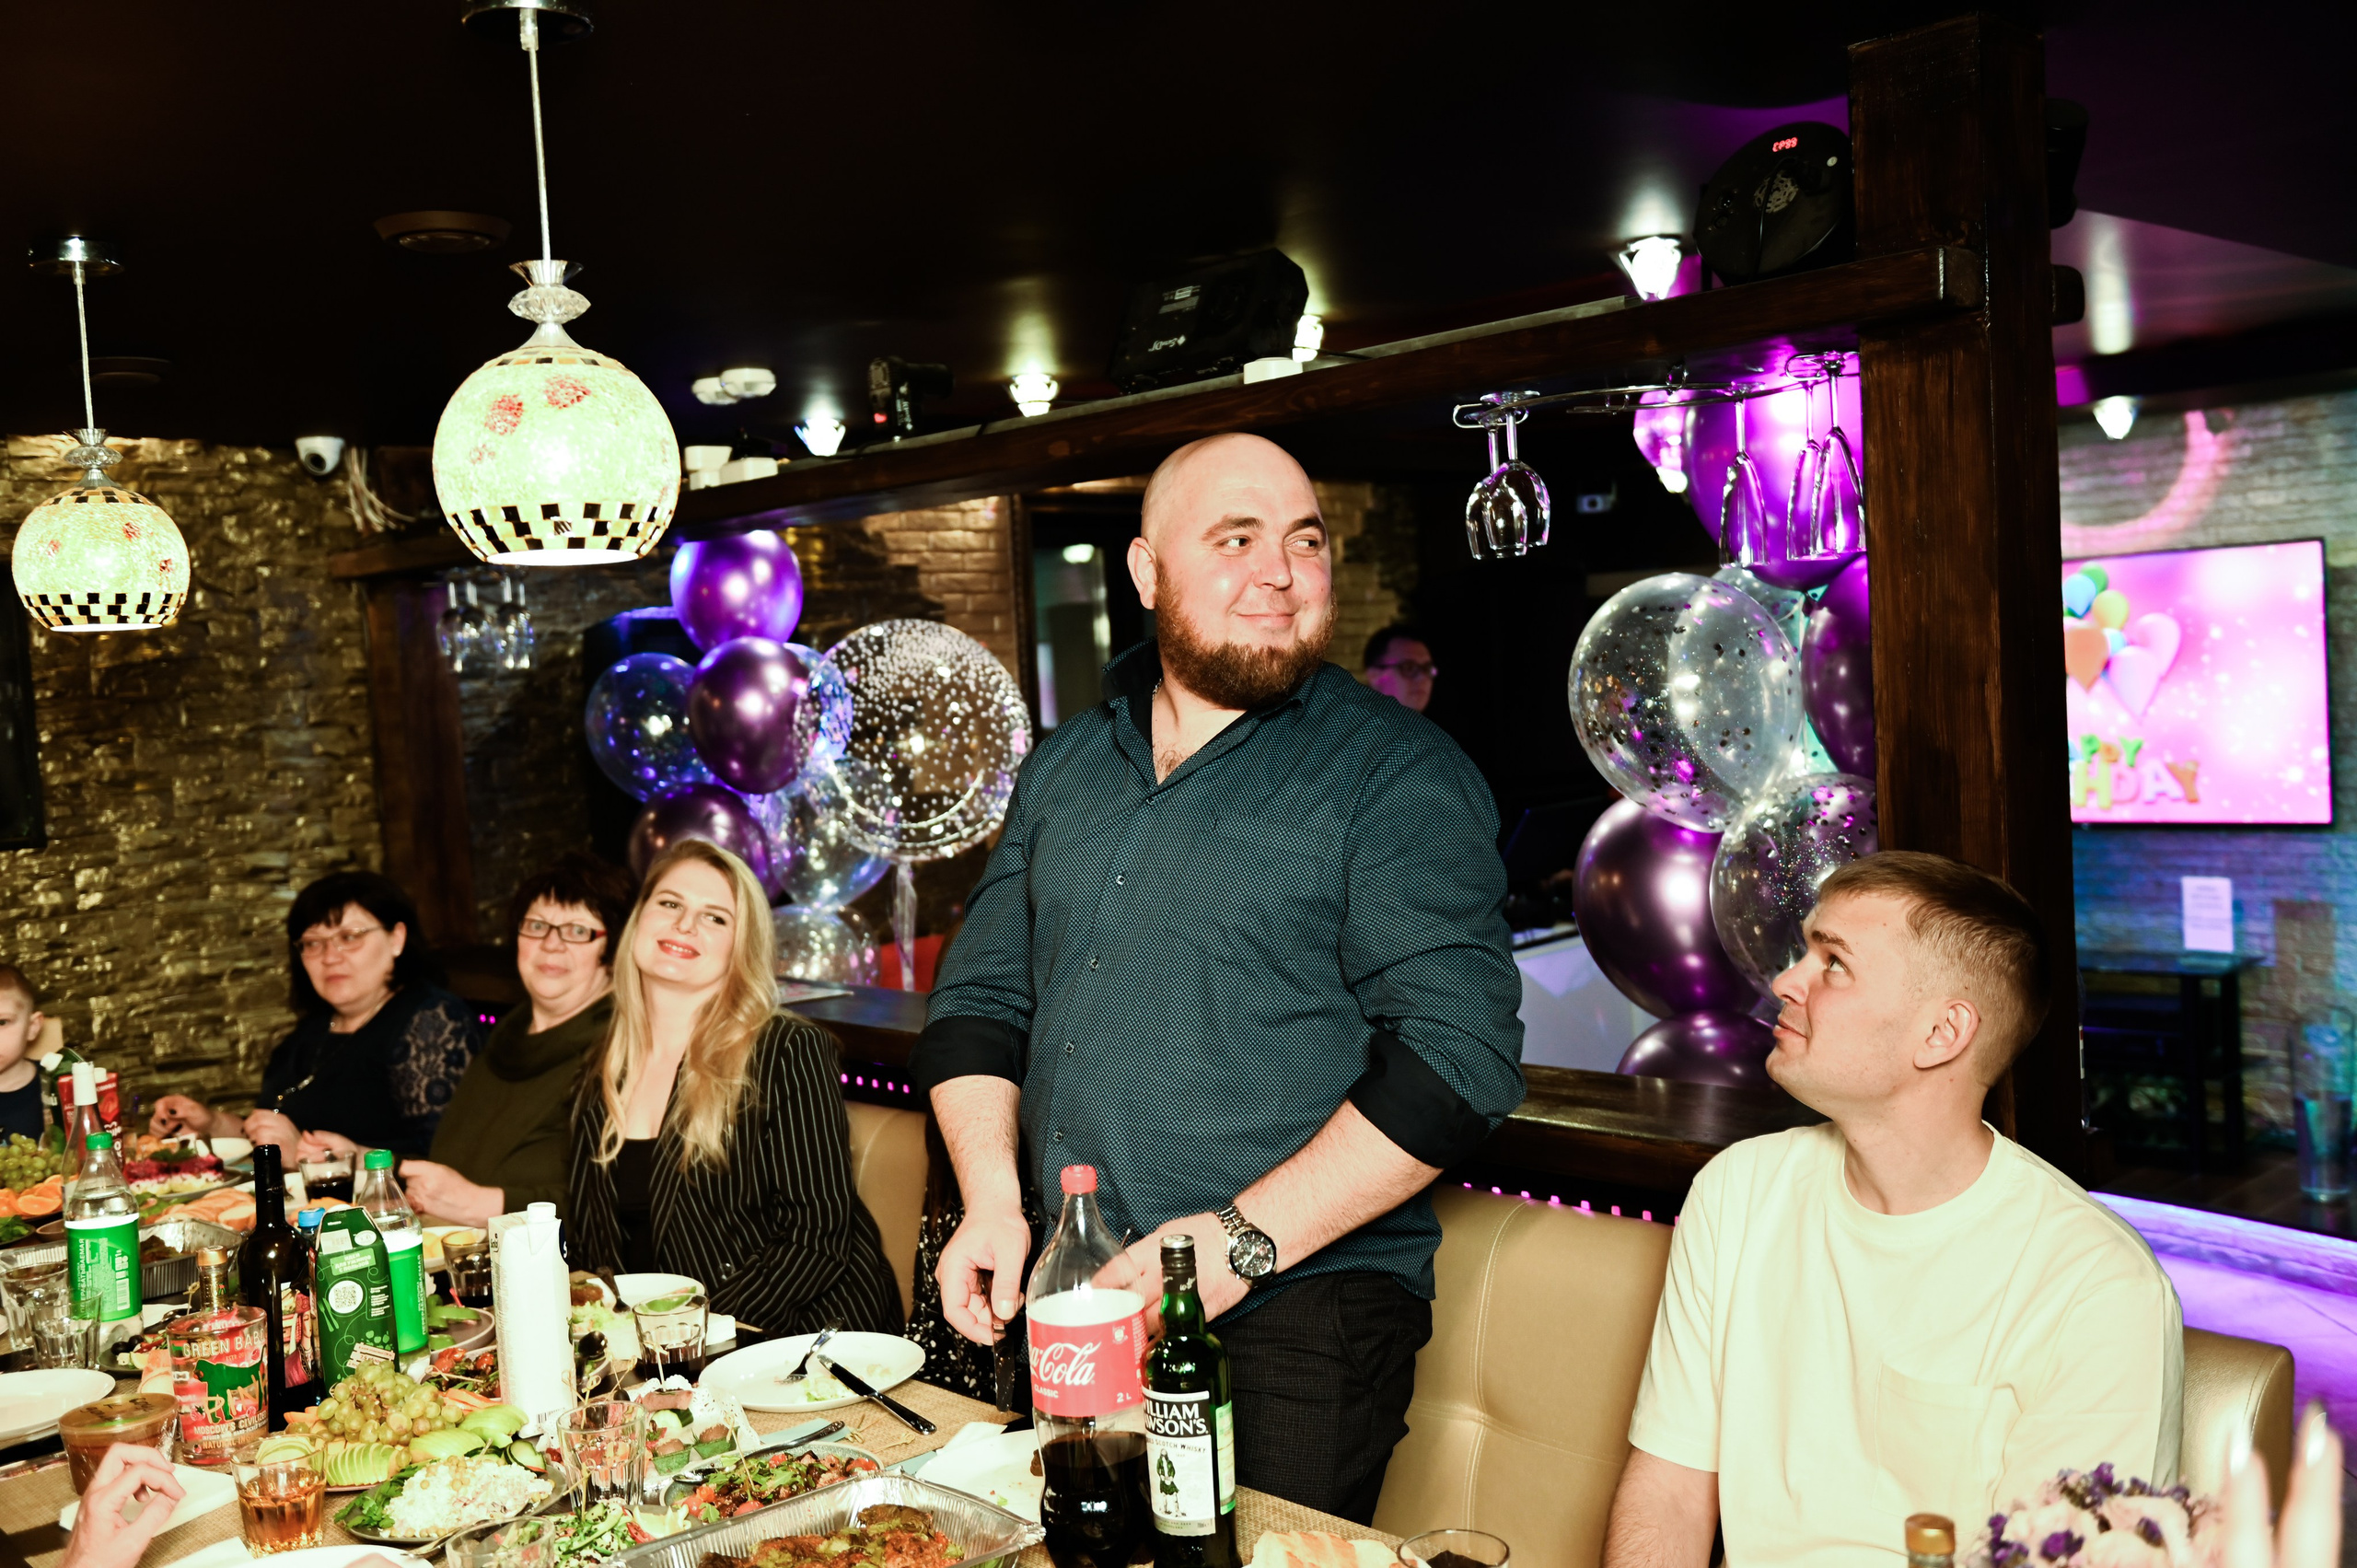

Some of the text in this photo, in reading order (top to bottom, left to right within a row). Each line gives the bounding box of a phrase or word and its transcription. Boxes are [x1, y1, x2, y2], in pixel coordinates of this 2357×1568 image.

[2073, 760, 2200, 811] HDAY
[77, 1238, 87, 1314] ПЕЕРАБАТЫВАЕМАЯ
[182, 1337, 230, 1357] GREEN
[1029, 1342, 1102, 1387] a-Cola
[1034, 1383, 1059, 1399] CLASSIC
[1117, 1392, 1124, 1403] 2
[1144, 1398, 1200, 1420] ILLIAM
[193, 1422, 236, 1434] MOSCOW'S
[1145, 1415, 1209, 1436] WSON'S.
[1155, 1438, 1178, 1448] SCOTCH
[1180, 1444, 1206, 1454] WHISKY
